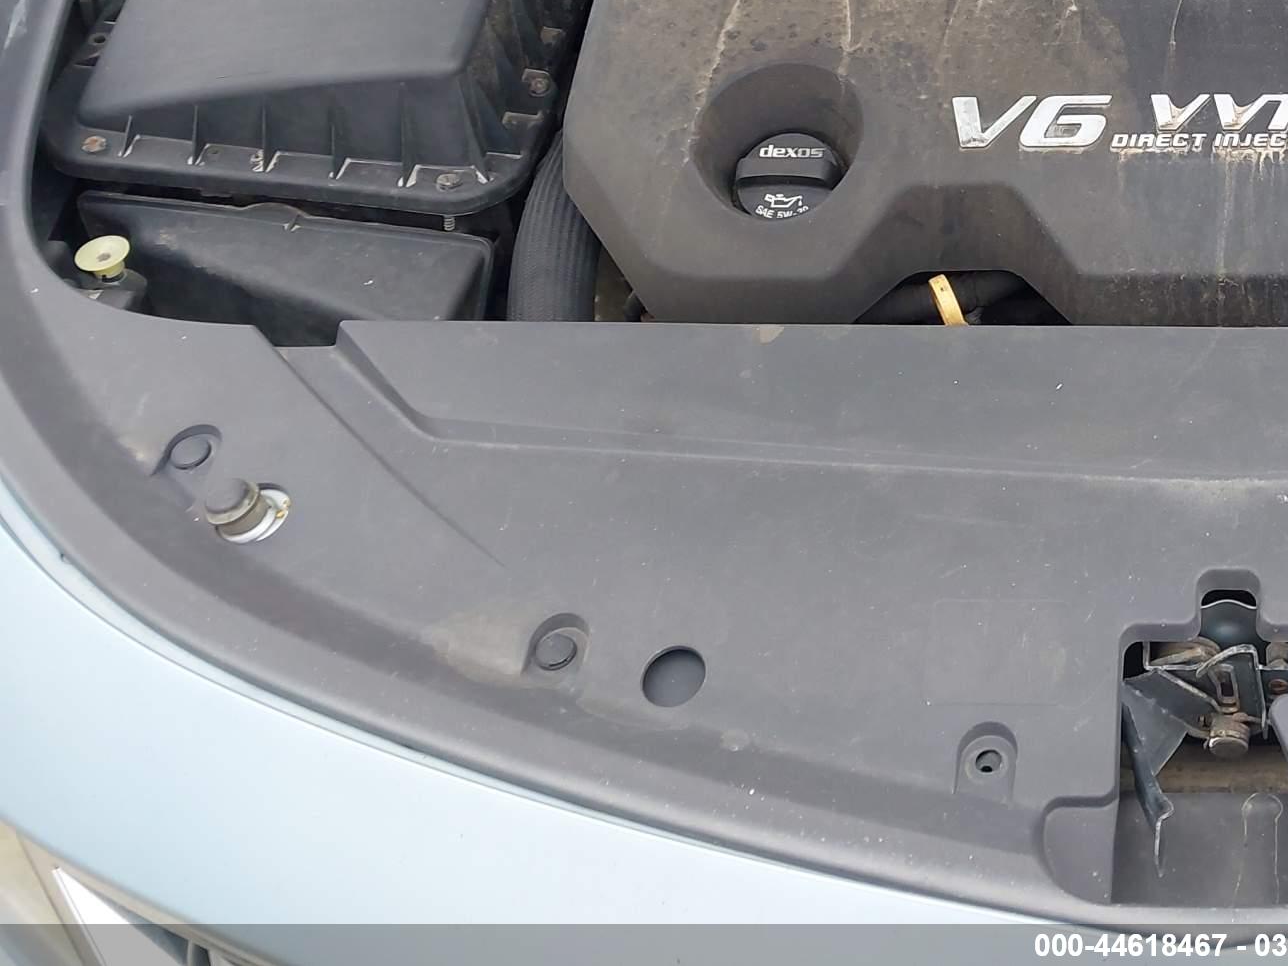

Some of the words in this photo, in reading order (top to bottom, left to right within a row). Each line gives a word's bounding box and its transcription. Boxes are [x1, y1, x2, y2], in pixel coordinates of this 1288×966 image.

[951, 94, 1113, 149] V6
[1111, 132, 1207, 149] DIRECT
[759, 144, 826, 159] dexos
[755, 205, 775, 219] SAE
